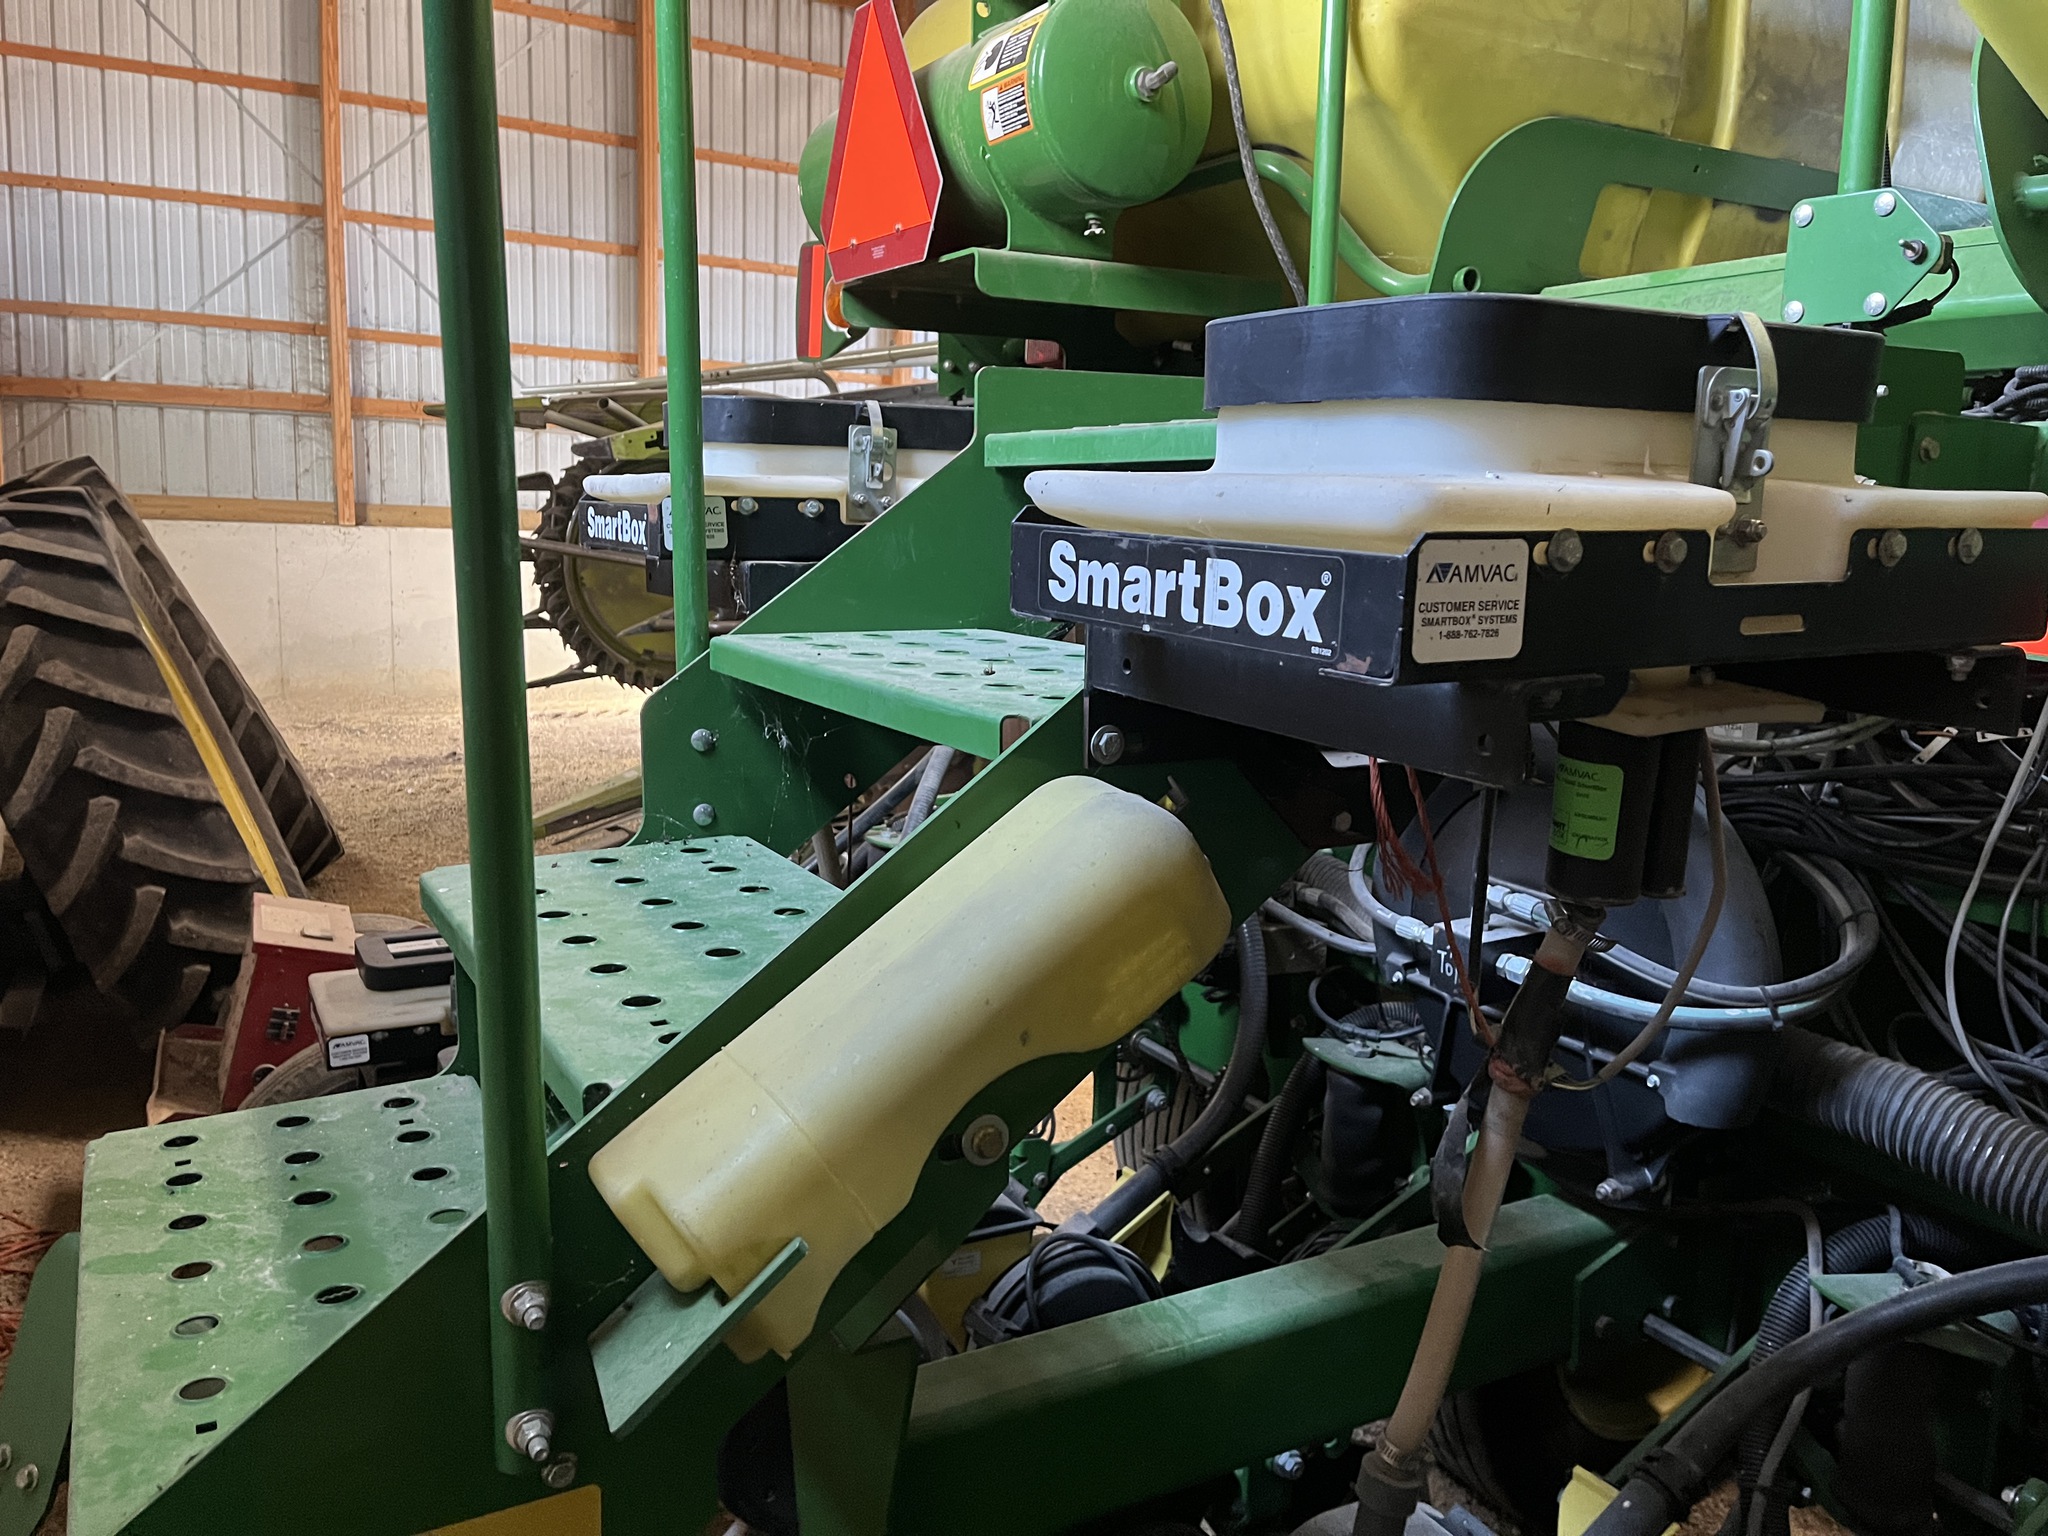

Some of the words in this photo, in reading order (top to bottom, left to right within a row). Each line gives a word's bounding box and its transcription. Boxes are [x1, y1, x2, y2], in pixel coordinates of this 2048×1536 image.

[1449, 564, 1516, 583] AMVAC
[1418, 601, 1475, 613] CUSTOMER
[1478, 600, 1520, 611] SERVICE
[1477, 614, 1518, 625] SYSTEMS
[1563, 767, 1601, 781] AMVAC
